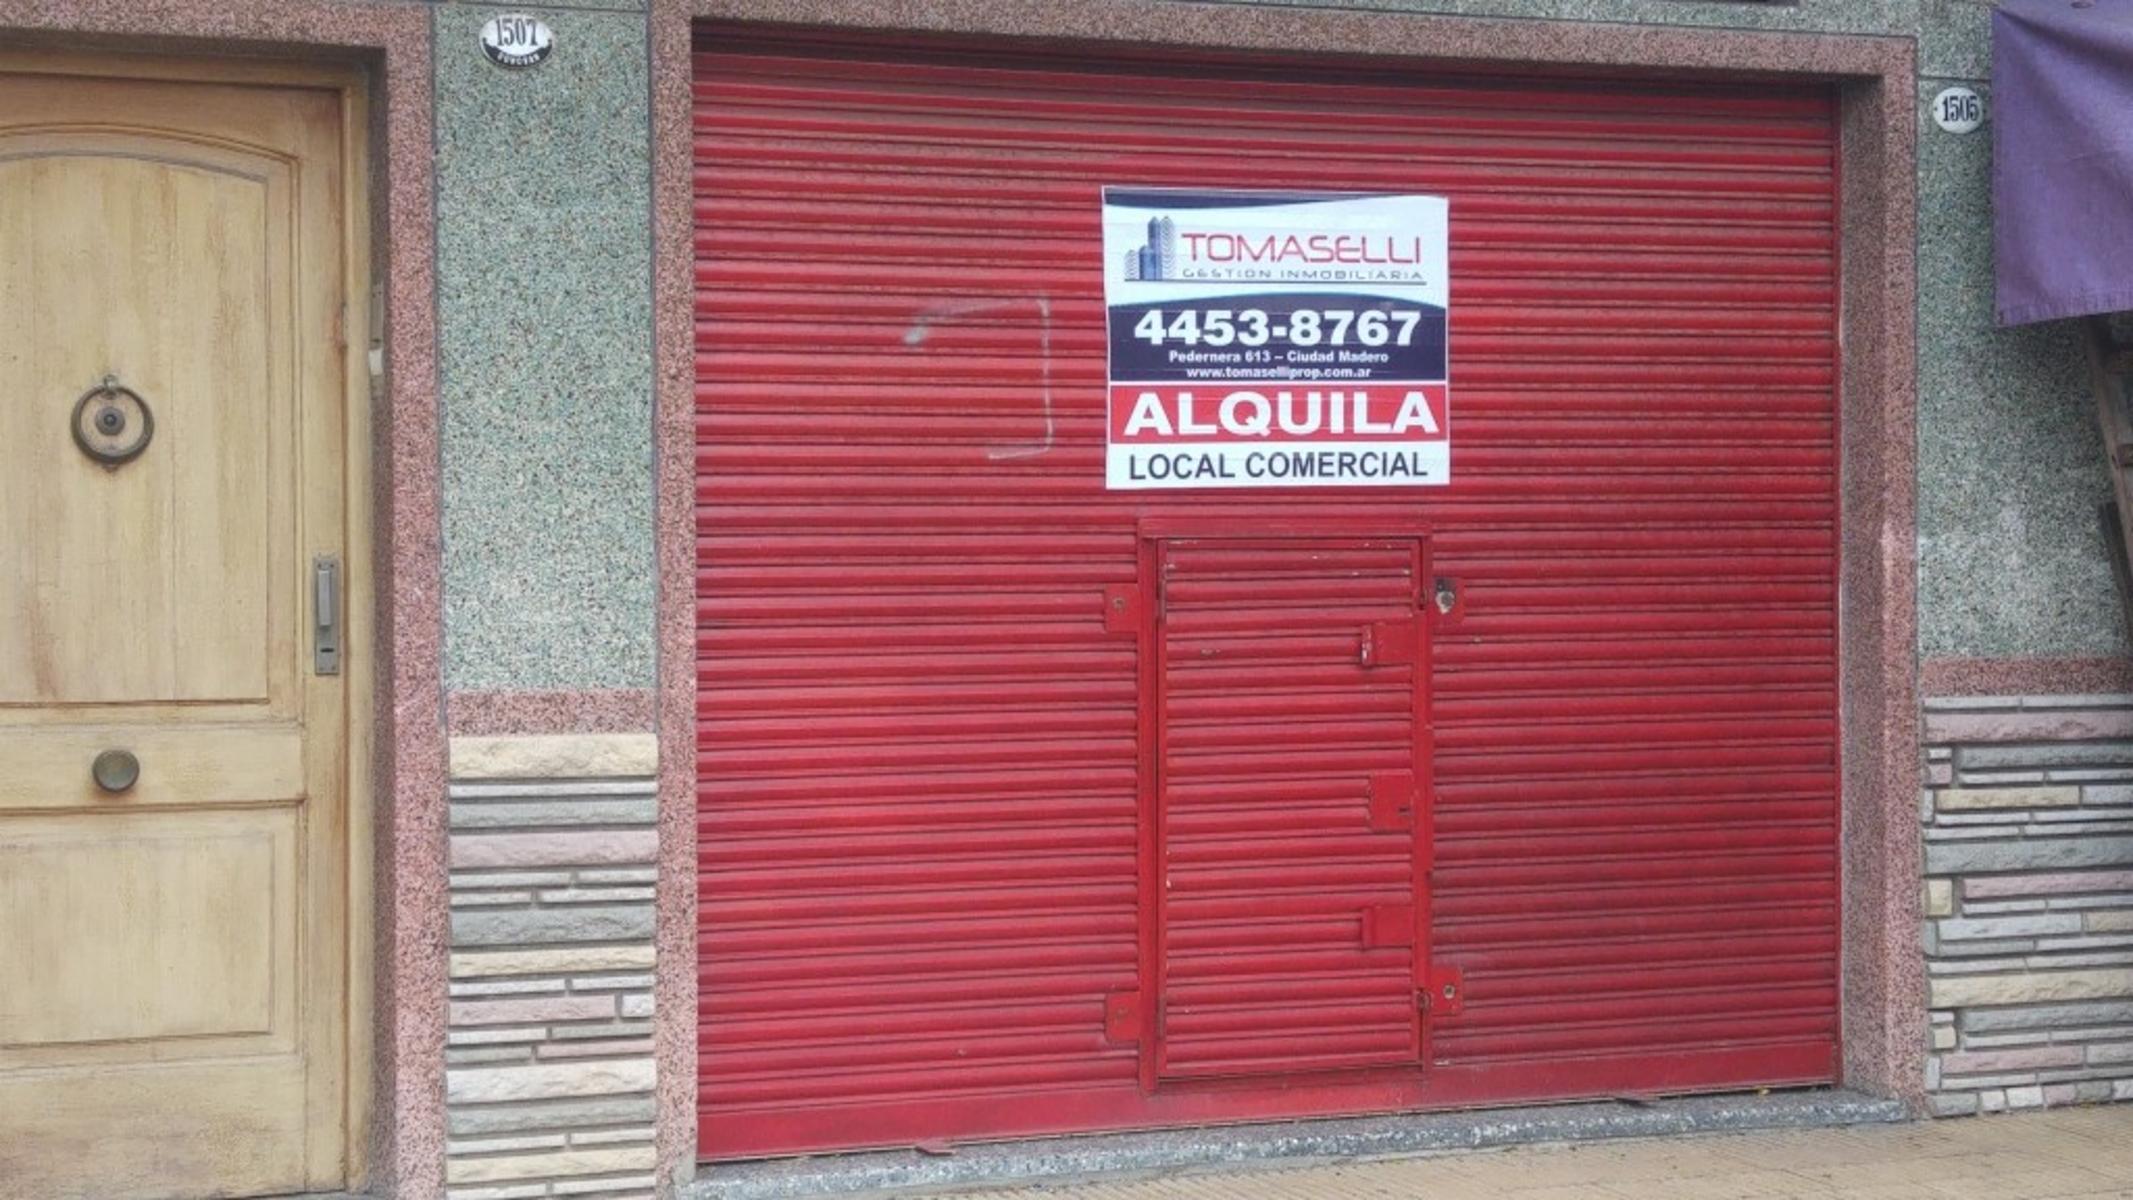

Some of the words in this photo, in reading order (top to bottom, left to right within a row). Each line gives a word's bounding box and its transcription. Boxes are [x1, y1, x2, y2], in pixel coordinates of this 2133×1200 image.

[496, 18, 538, 46] 1507
[1942, 95, 1979, 122] 1505
[1182, 233, 1420, 264] TOMASELLI
[1183, 268, 1272, 278] GESTION
[1281, 268, 1423, 280] INMOBILIARIA
[1134, 309, 1421, 346] 4453-8767
[1169, 350, 1241, 363] Pedernera
[1245, 350, 1271, 363] 613
[1287, 350, 1335, 363] Ciudad
[1339, 350, 1389, 363] Madero
[1186, 366, 1372, 380] www.tomaselliprop.com.ar
[1124, 391, 1439, 436] ALQUILA
[1129, 454, 1235, 480] LOCAL
[1245, 451, 1428, 478] COMERCIAL
